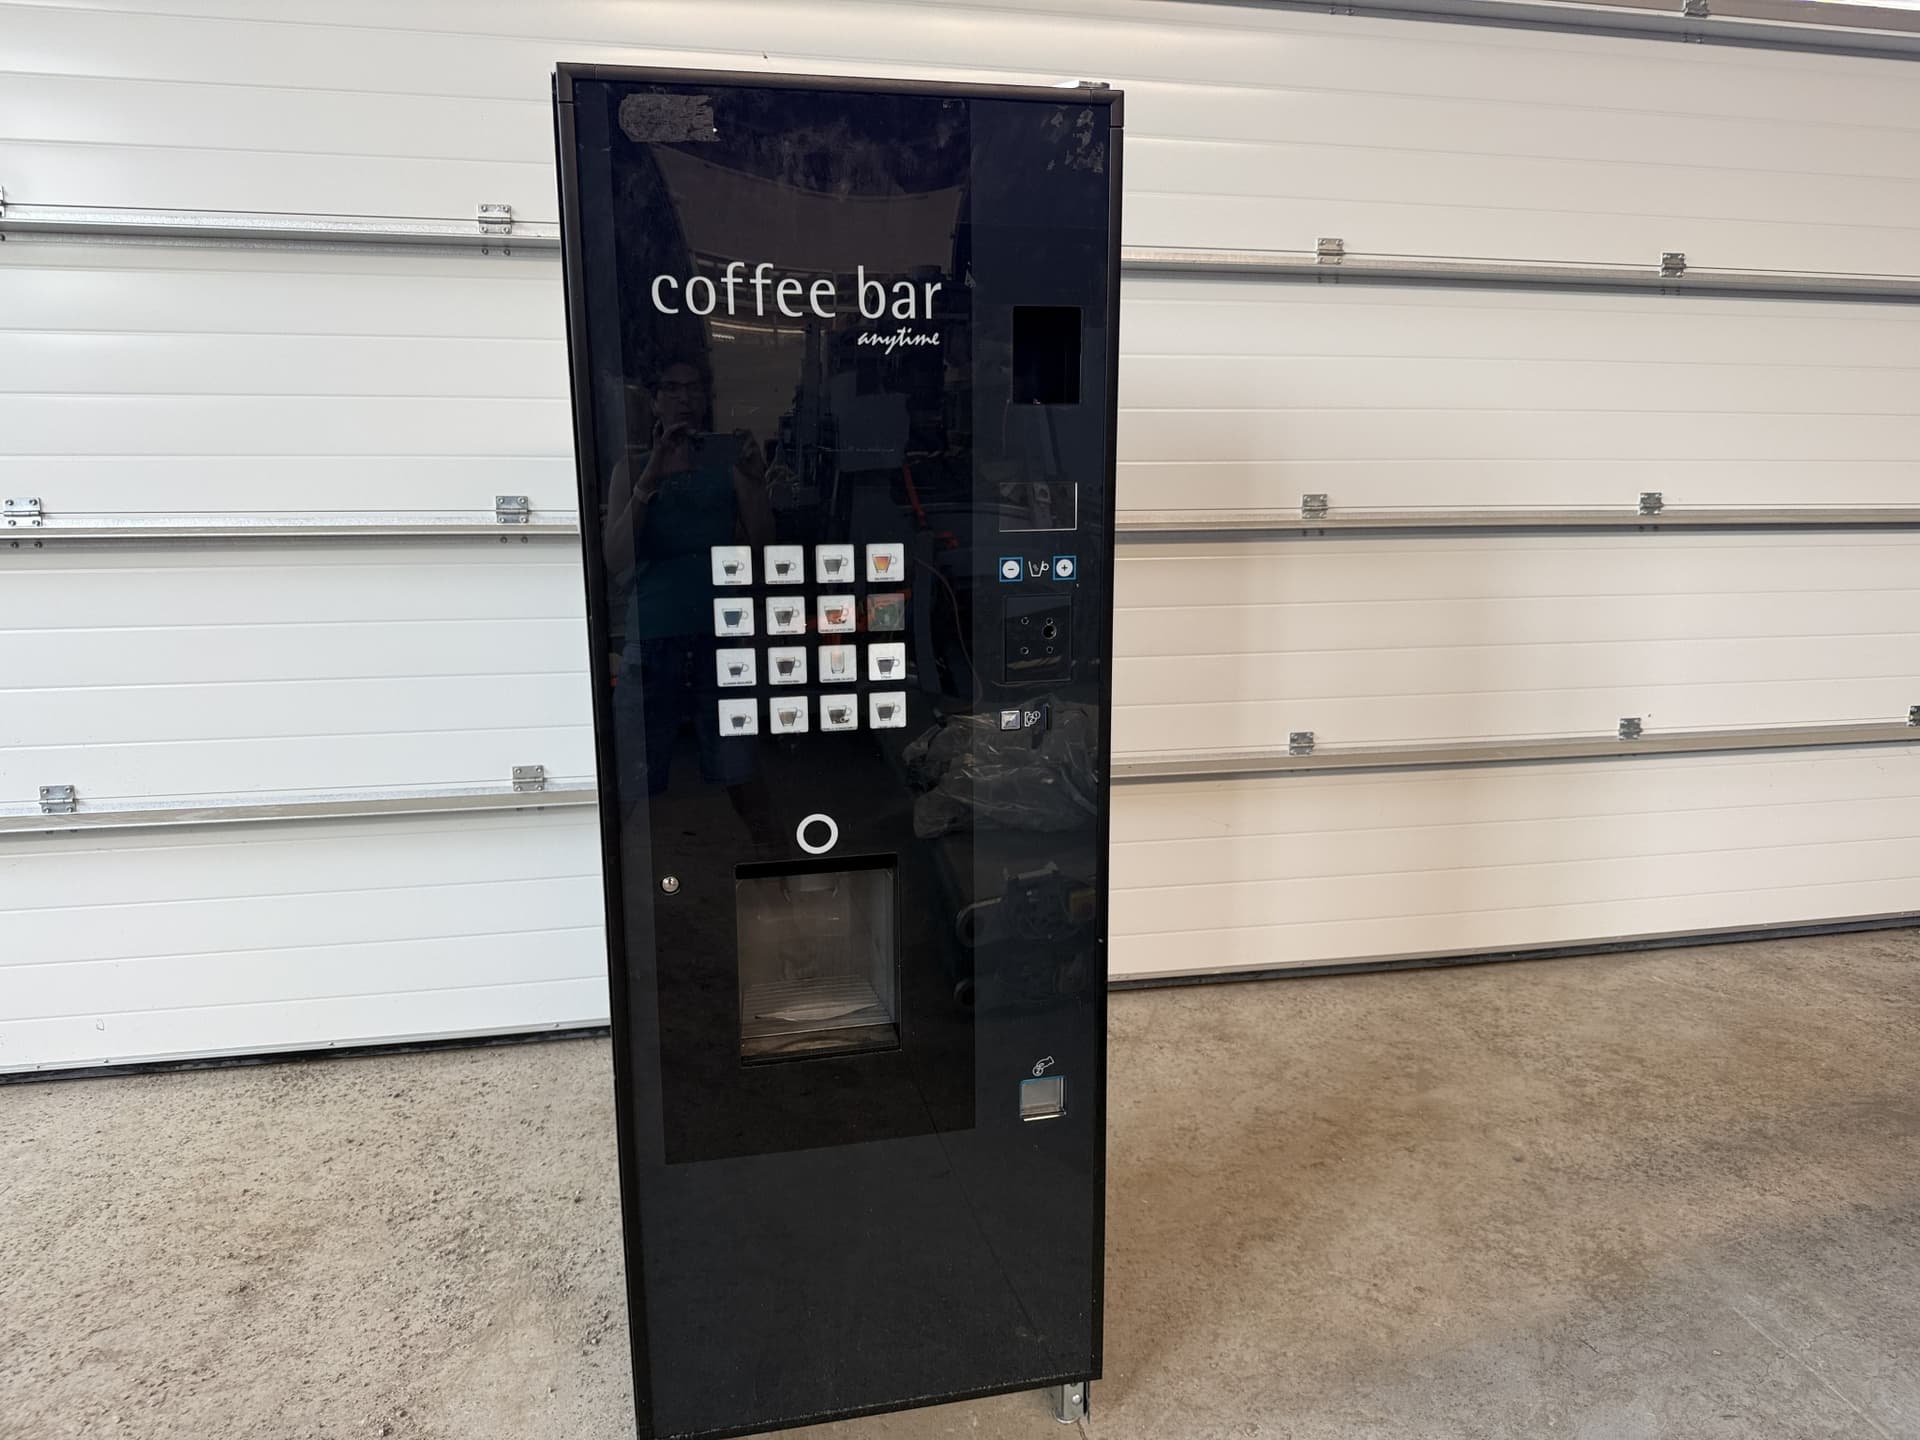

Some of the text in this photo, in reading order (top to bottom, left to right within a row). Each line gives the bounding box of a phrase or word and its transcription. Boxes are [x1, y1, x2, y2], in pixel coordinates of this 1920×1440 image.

[651, 261, 942, 320] coffee bar
[857, 326, 940, 355] anytime
